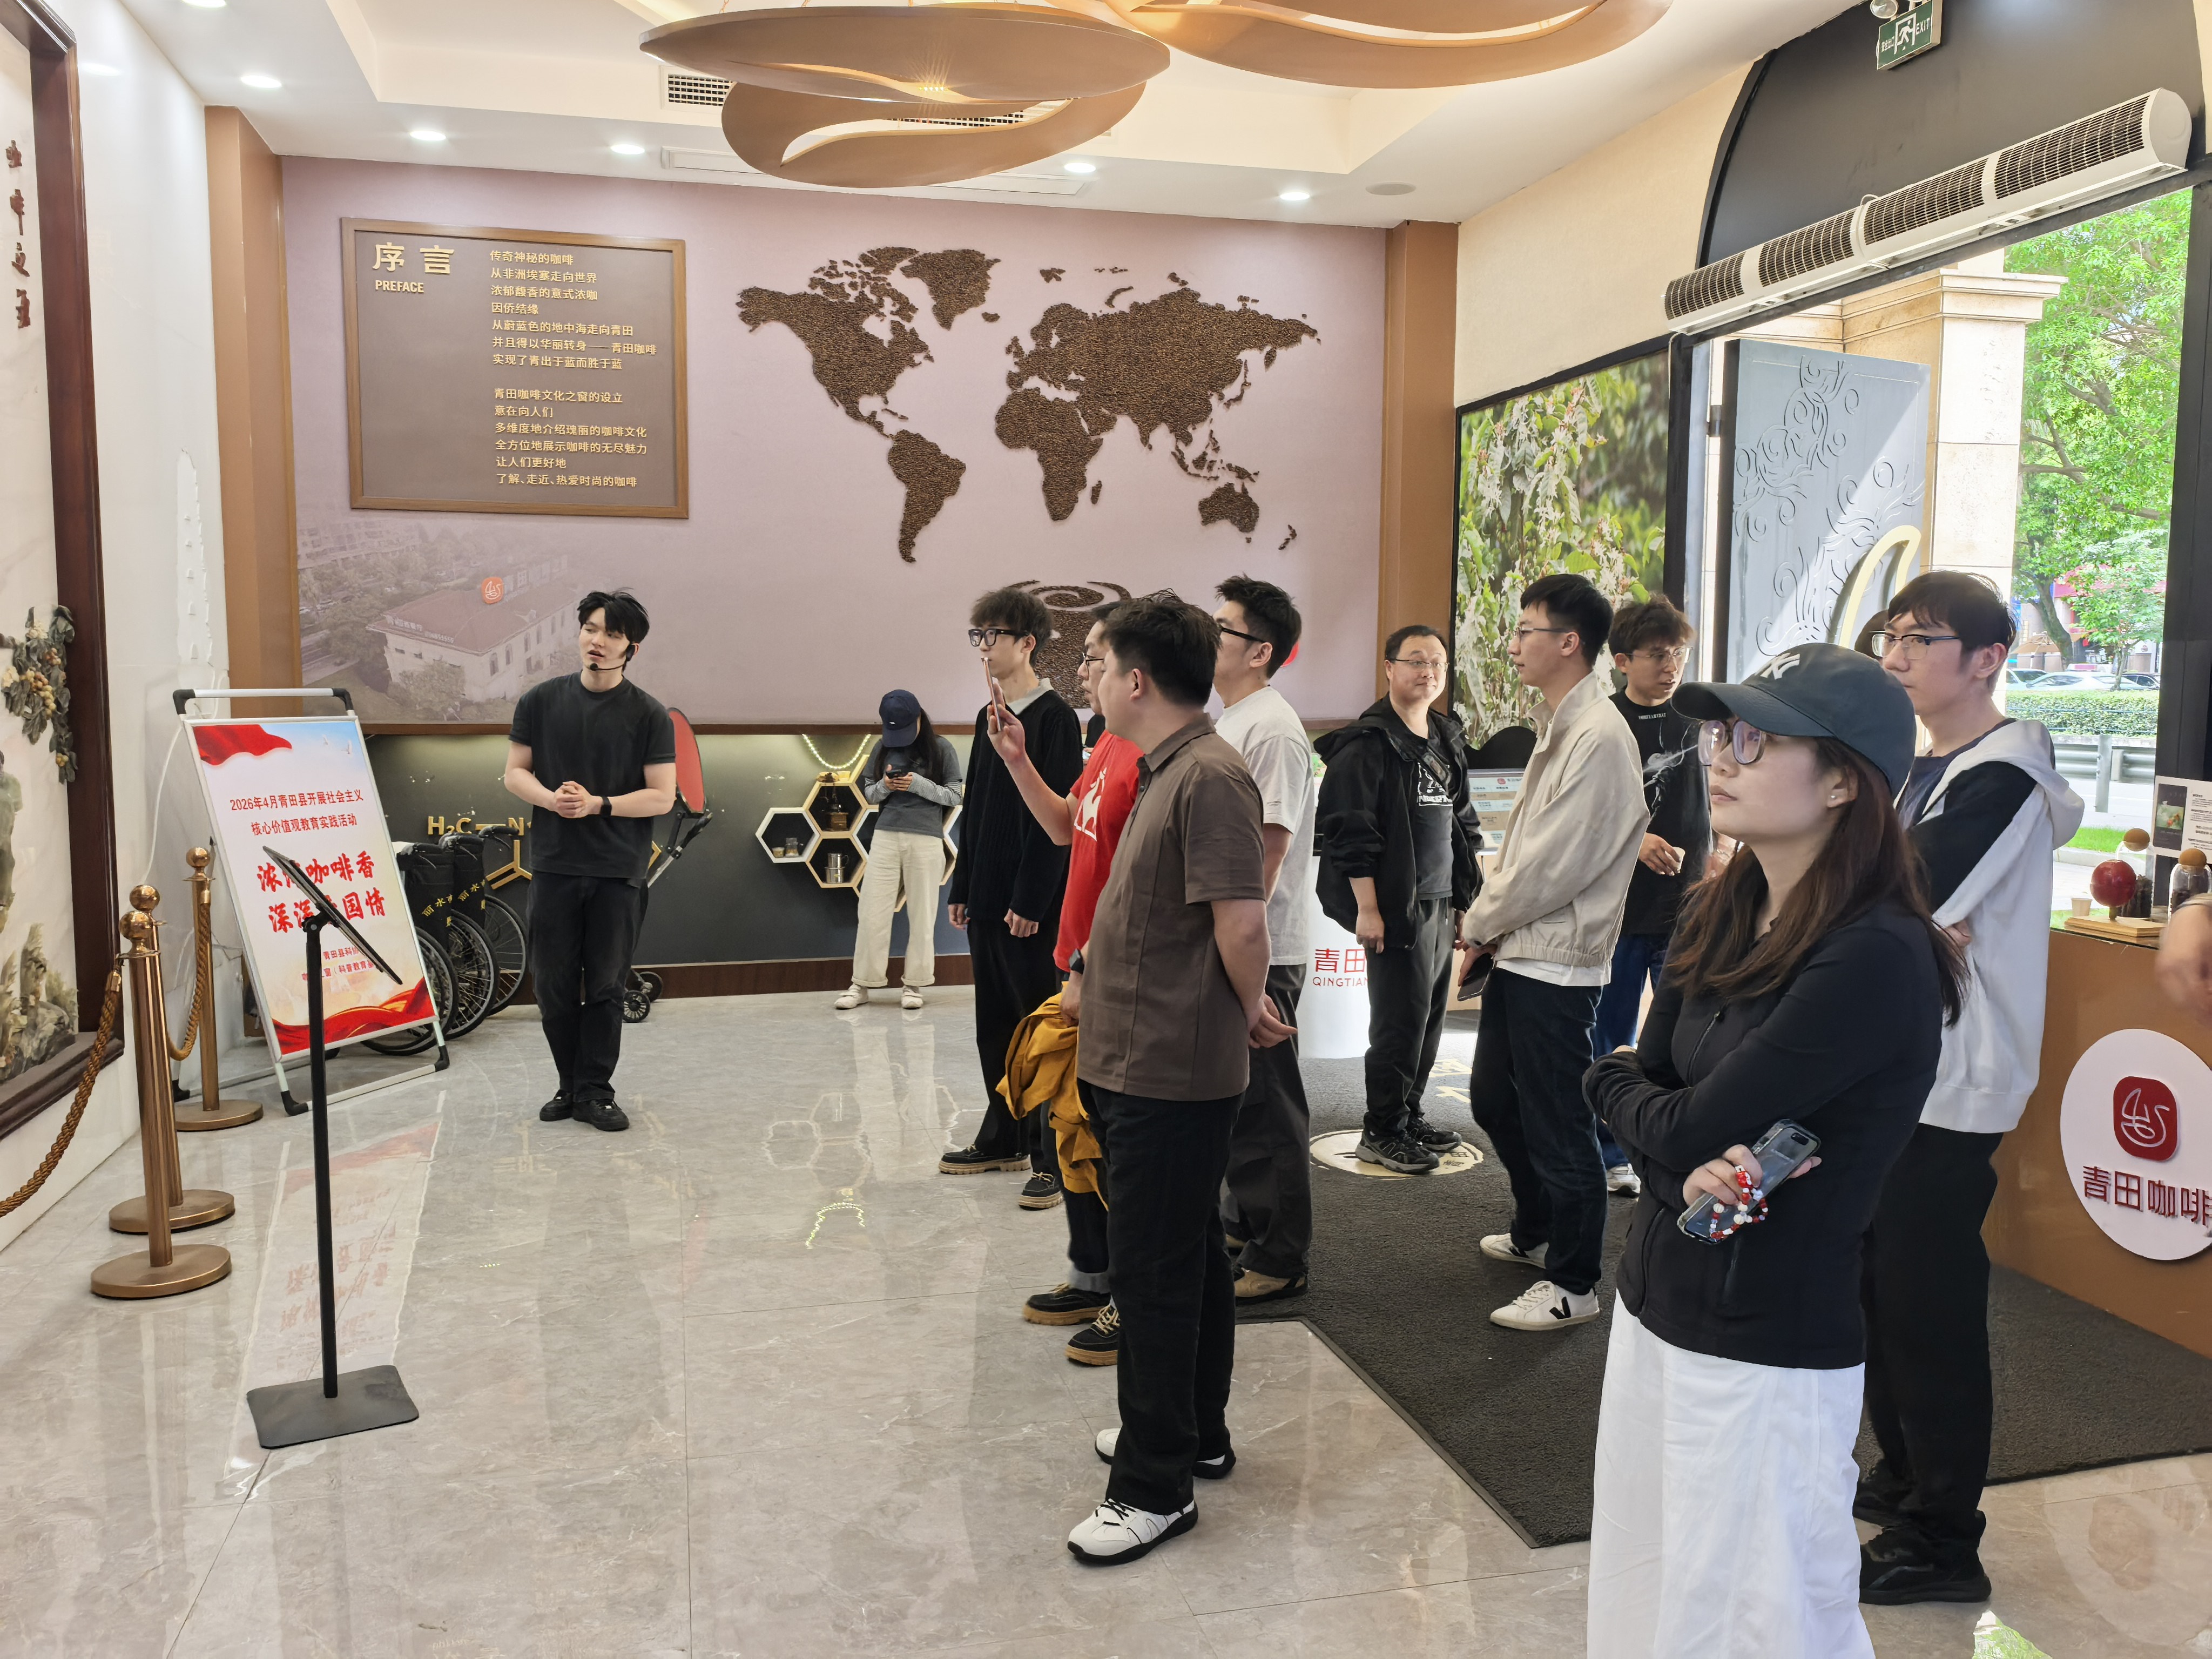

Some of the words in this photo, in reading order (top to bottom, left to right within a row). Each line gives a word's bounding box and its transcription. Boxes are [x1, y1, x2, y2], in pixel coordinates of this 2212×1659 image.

[1916, 17, 1930, 35] EXIT
[372, 242, 455, 274] 序言
[490, 250, 574, 265] 传奇神秘的咖啡
[490, 267, 597, 283] 从非洲埃塞走向世界
[375, 280, 424, 293] PREFACE
[490, 285, 598, 300] 浓郁馥香的意式浓咖
[491, 302, 539, 315] 因侨结缘
[492, 319, 633, 336] 从蔚蓝色的地中海走向青田
[493, 354, 623, 370] 实现了青出于蓝而胜于蓝
[494, 388, 623, 403] 青田咖啡文化之窗的设立
[494, 405, 554, 418] 意在向人们
[495, 422, 647, 438] 多维度地介绍瑰丽的咖啡文化
[495, 439, 647, 455] 全方位地展示咖啡的无尽魅力
[496, 456, 567, 468] 让人们更好地
[496, 473, 637, 487] 了解、走近、热爱时尚的咖啡
[230, 789, 364, 811] 2026年4月青田县开展社会主义
[251, 812, 358, 837] 核心价值观教育实践活动
[257, 850, 375, 893] 浓咖啡香
[268, 887, 386, 933] 深深国情
[1314, 948, 1367, 973] 青田
[2083, 1165, 2212, 1226] 青田咖啡
